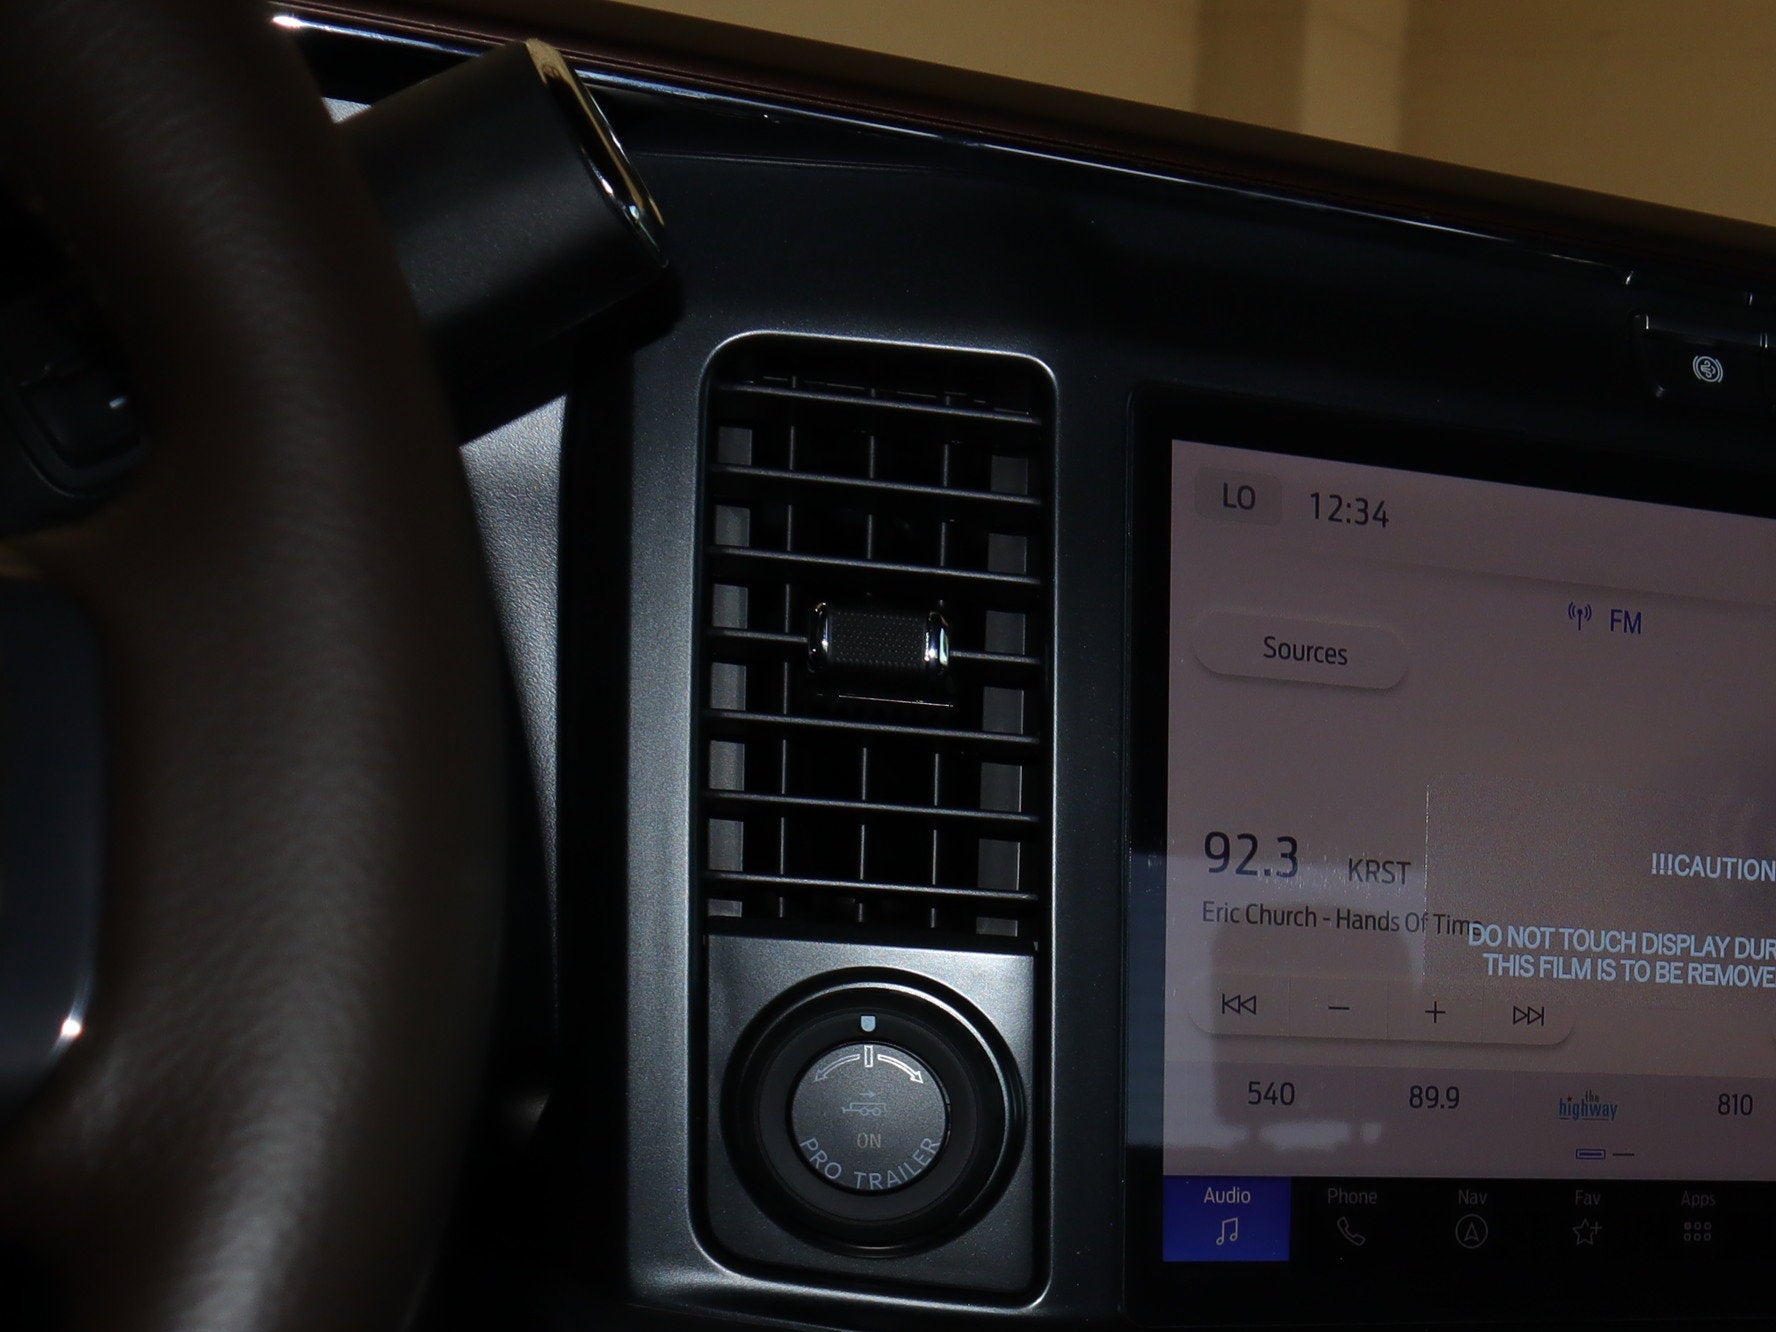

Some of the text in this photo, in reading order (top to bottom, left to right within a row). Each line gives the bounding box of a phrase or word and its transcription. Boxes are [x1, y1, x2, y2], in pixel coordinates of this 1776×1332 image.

[1222, 483, 1255, 509] LO
[1310, 492, 1390, 528] 12:34
[1610, 609, 1642, 635] FM
[1264, 636, 1348, 666] Sources
[1204, 831, 1298, 878] 92.3
[1348, 858, 1411, 885] KRST
[1202, 901, 1240, 924] Eric
[1246, 903, 1316, 928] Church
[1336, 908, 1399, 931] Hands
[1405, 912, 1428, 933] Of
[1468, 922, 1503, 947] DO
[1507, 925, 1556, 949] NOT
[1559, 927, 1637, 954] TOUCH
[1641, 931, 1730, 958] DISPLAY
[1482, 952, 1535, 978] THIS
[1540, 955, 1592, 980] FILM
[1597, 958, 1617, 981] IS
[1620, 959, 1650, 984] TO
[1655, 961, 1684, 984] BE
[1248, 1082, 1295, 1106] 540
[1409, 1086, 1460, 1110] 89.9
[1718, 1093, 1753, 1116] 810
[1559, 1097, 1618, 1121] highway
[857, 1133, 881, 1149] ON
[800, 1137, 942, 1190] PRO TRAILER
[1203, 1187, 1251, 1204] Audio
[1327, 1188, 1378, 1205] Phone
[1457, 1189, 1488, 1206] Nav
[1575, 1189, 1601, 1206] Fav
[1681, 1192, 1715, 1209] Apps
